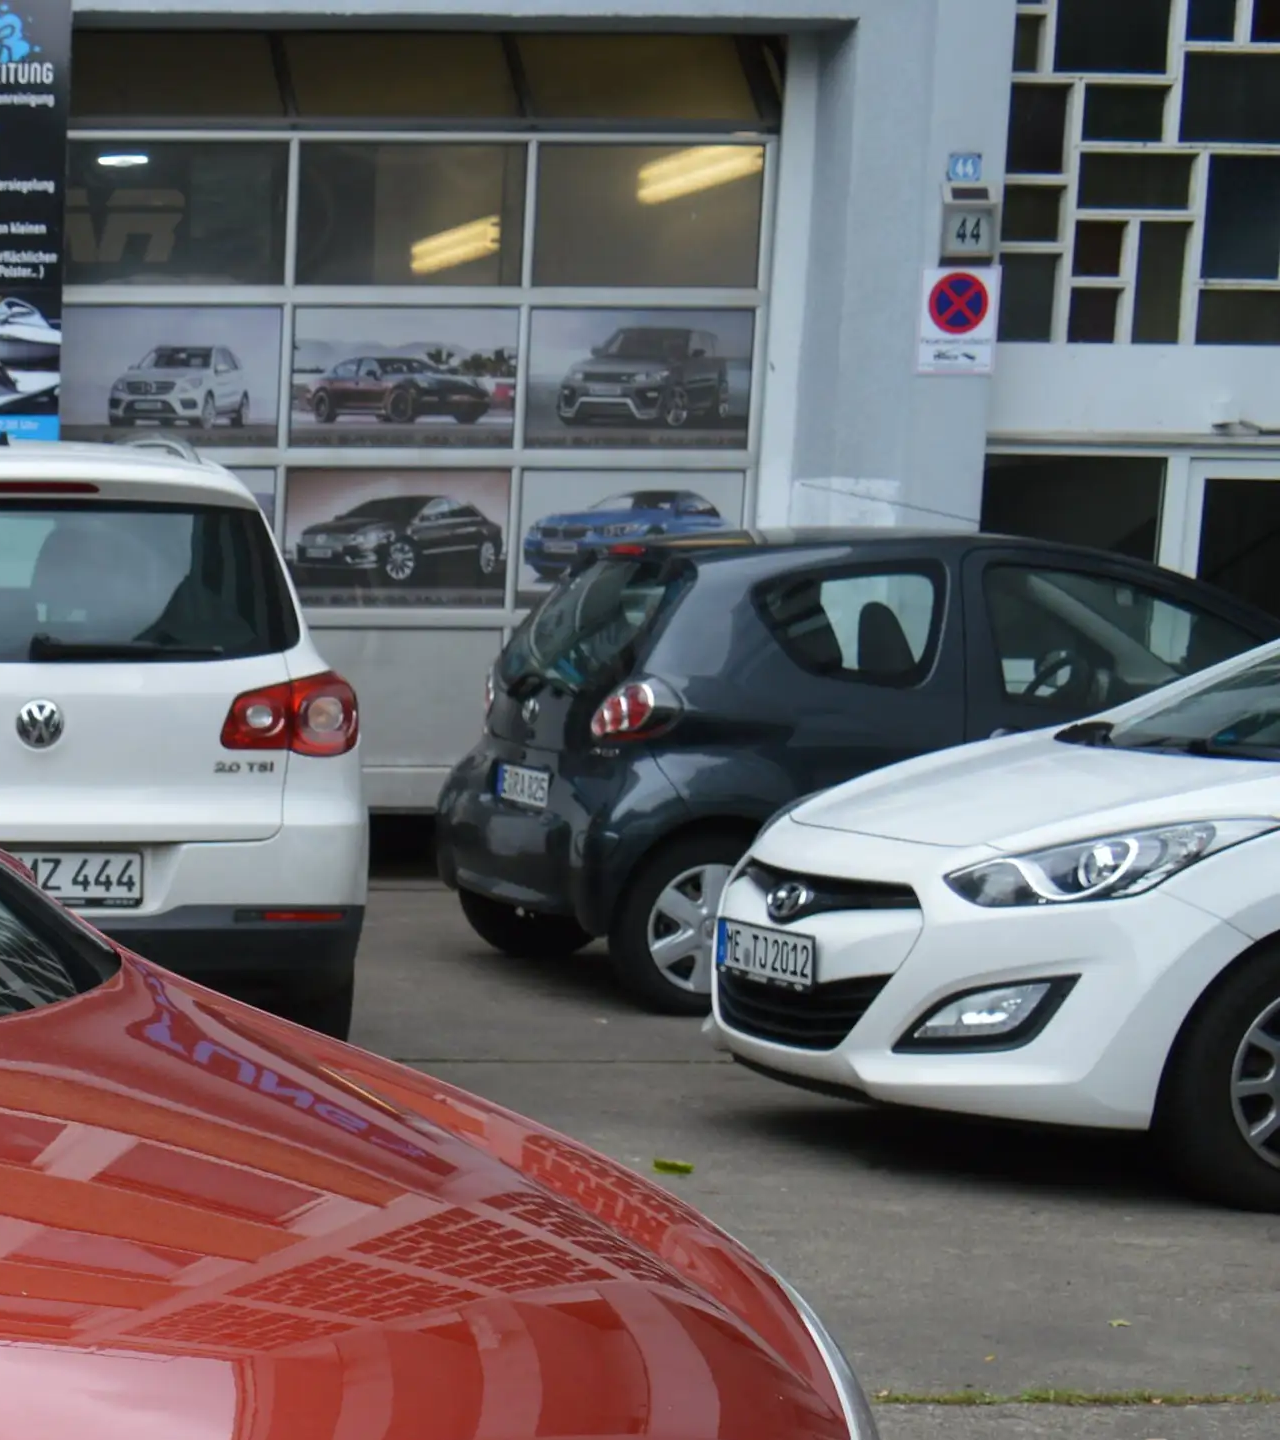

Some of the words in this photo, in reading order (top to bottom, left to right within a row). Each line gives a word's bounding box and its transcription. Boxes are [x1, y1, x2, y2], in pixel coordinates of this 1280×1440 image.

[955, 217, 981, 245] 44
[246, 761, 274, 774] TSI
[71, 858, 136, 893] 444
[726, 927, 741, 963] ME
[752, 933, 768, 970] TJ
[771, 938, 810, 979] 2012
